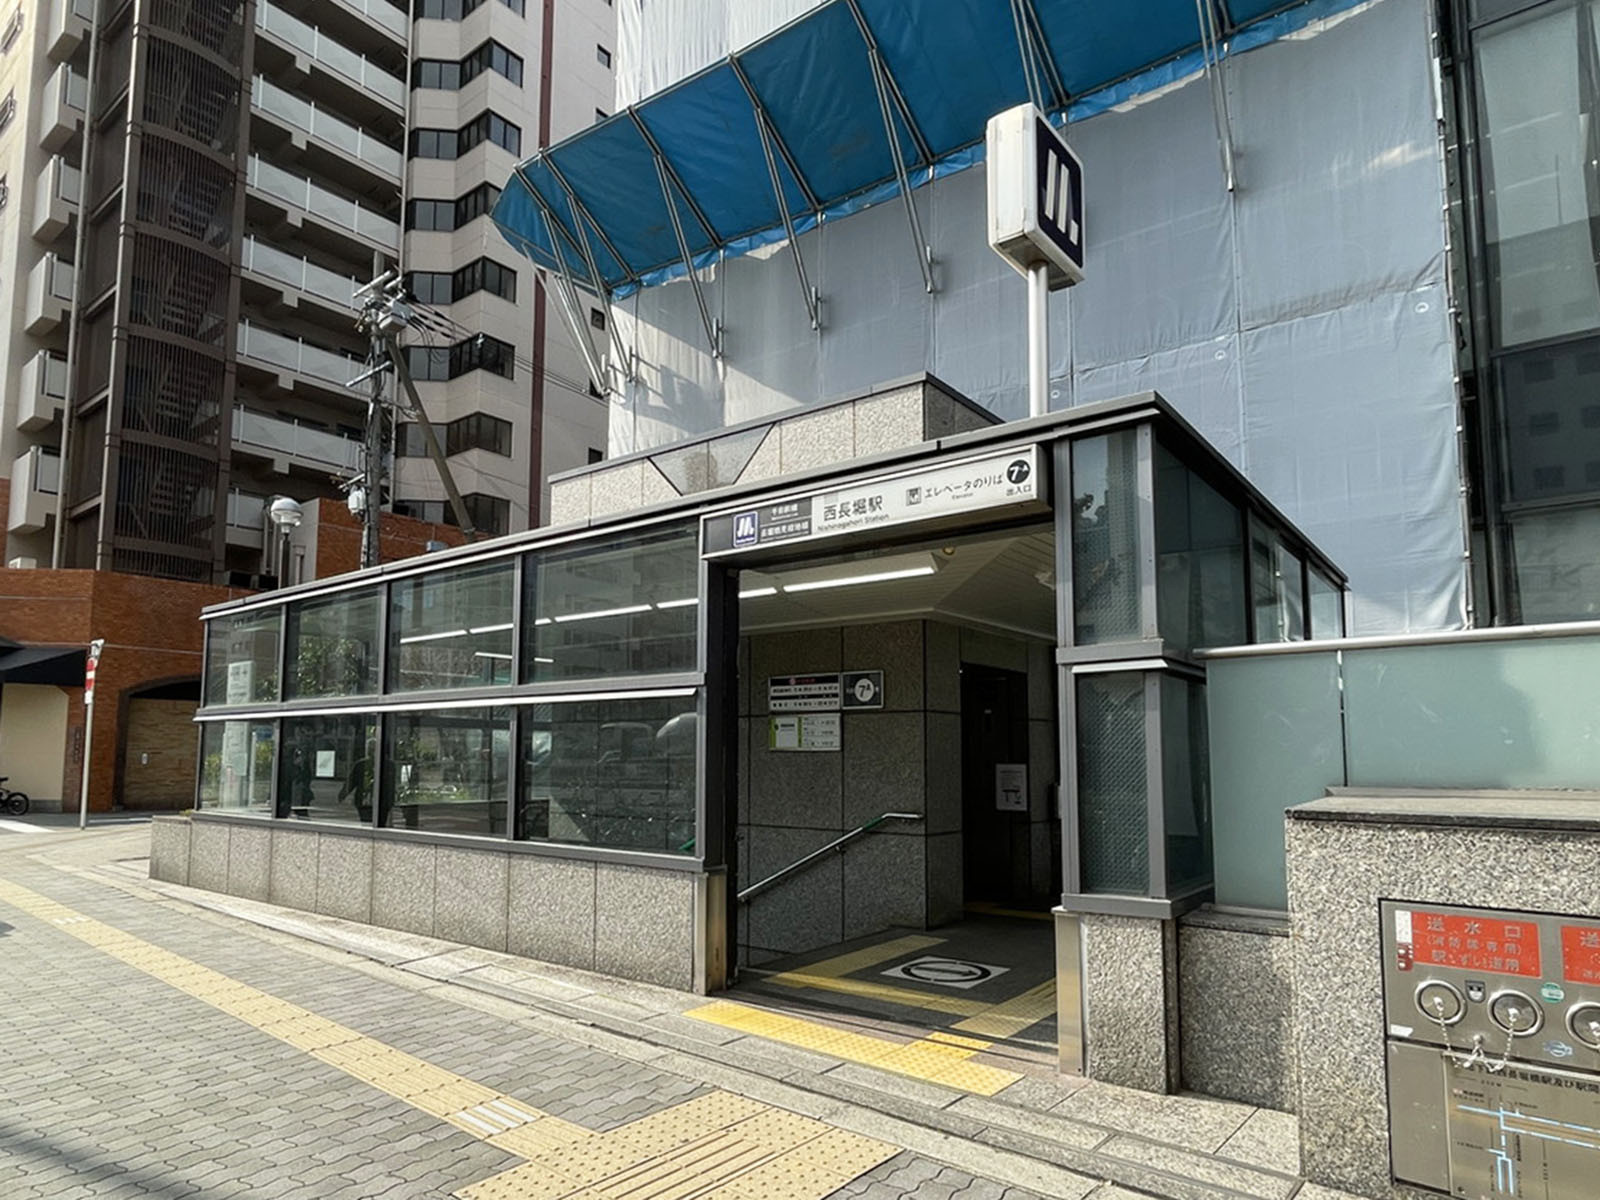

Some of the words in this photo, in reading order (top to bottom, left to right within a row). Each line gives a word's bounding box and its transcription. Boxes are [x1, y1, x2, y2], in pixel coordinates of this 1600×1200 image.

[925, 474, 1003, 499] エレベータのりば
[1006, 484, 1032, 497] 出入口
[823, 495, 883, 522] 西長堀駅
[1427, 916, 1522, 939] 送水口
